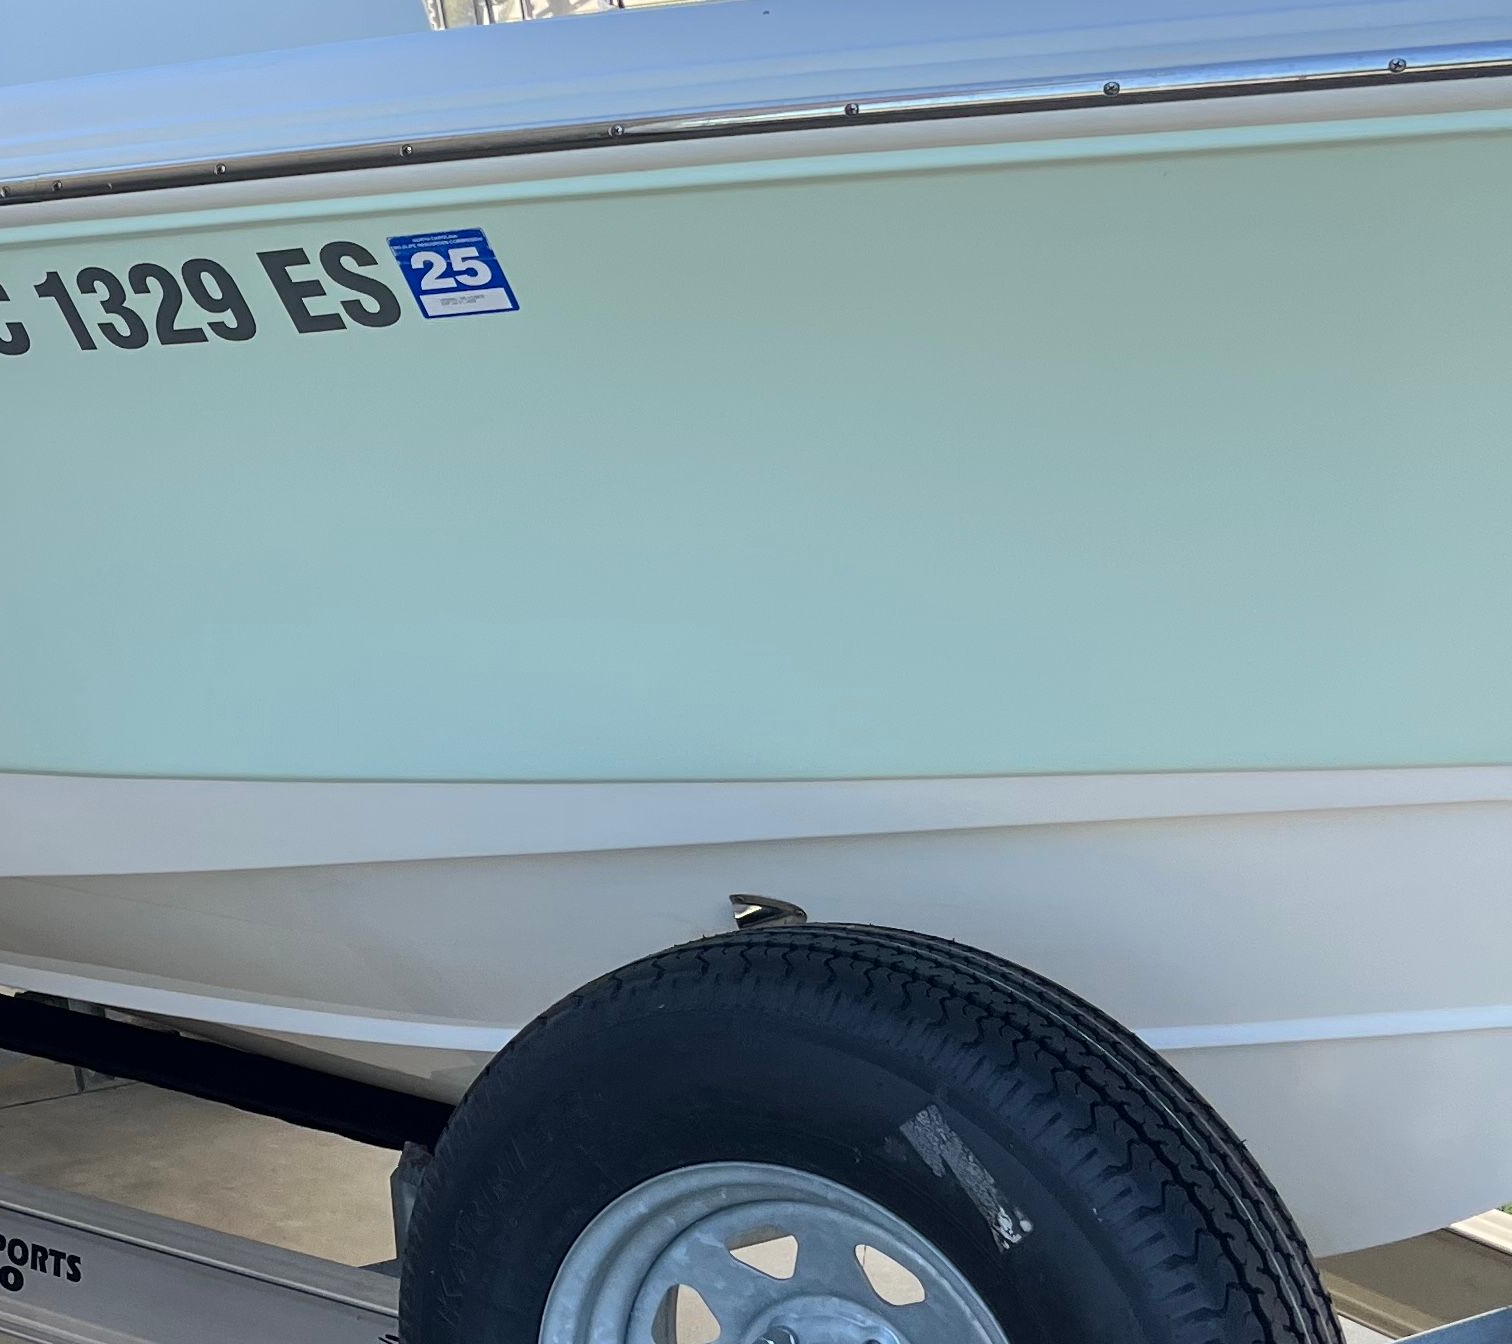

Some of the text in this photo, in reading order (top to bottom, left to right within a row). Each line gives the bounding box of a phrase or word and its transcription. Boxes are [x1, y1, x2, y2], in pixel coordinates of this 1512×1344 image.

[33, 258, 257, 350] 1329
[255, 241, 401, 334] ES
[410, 246, 492, 291] 25
